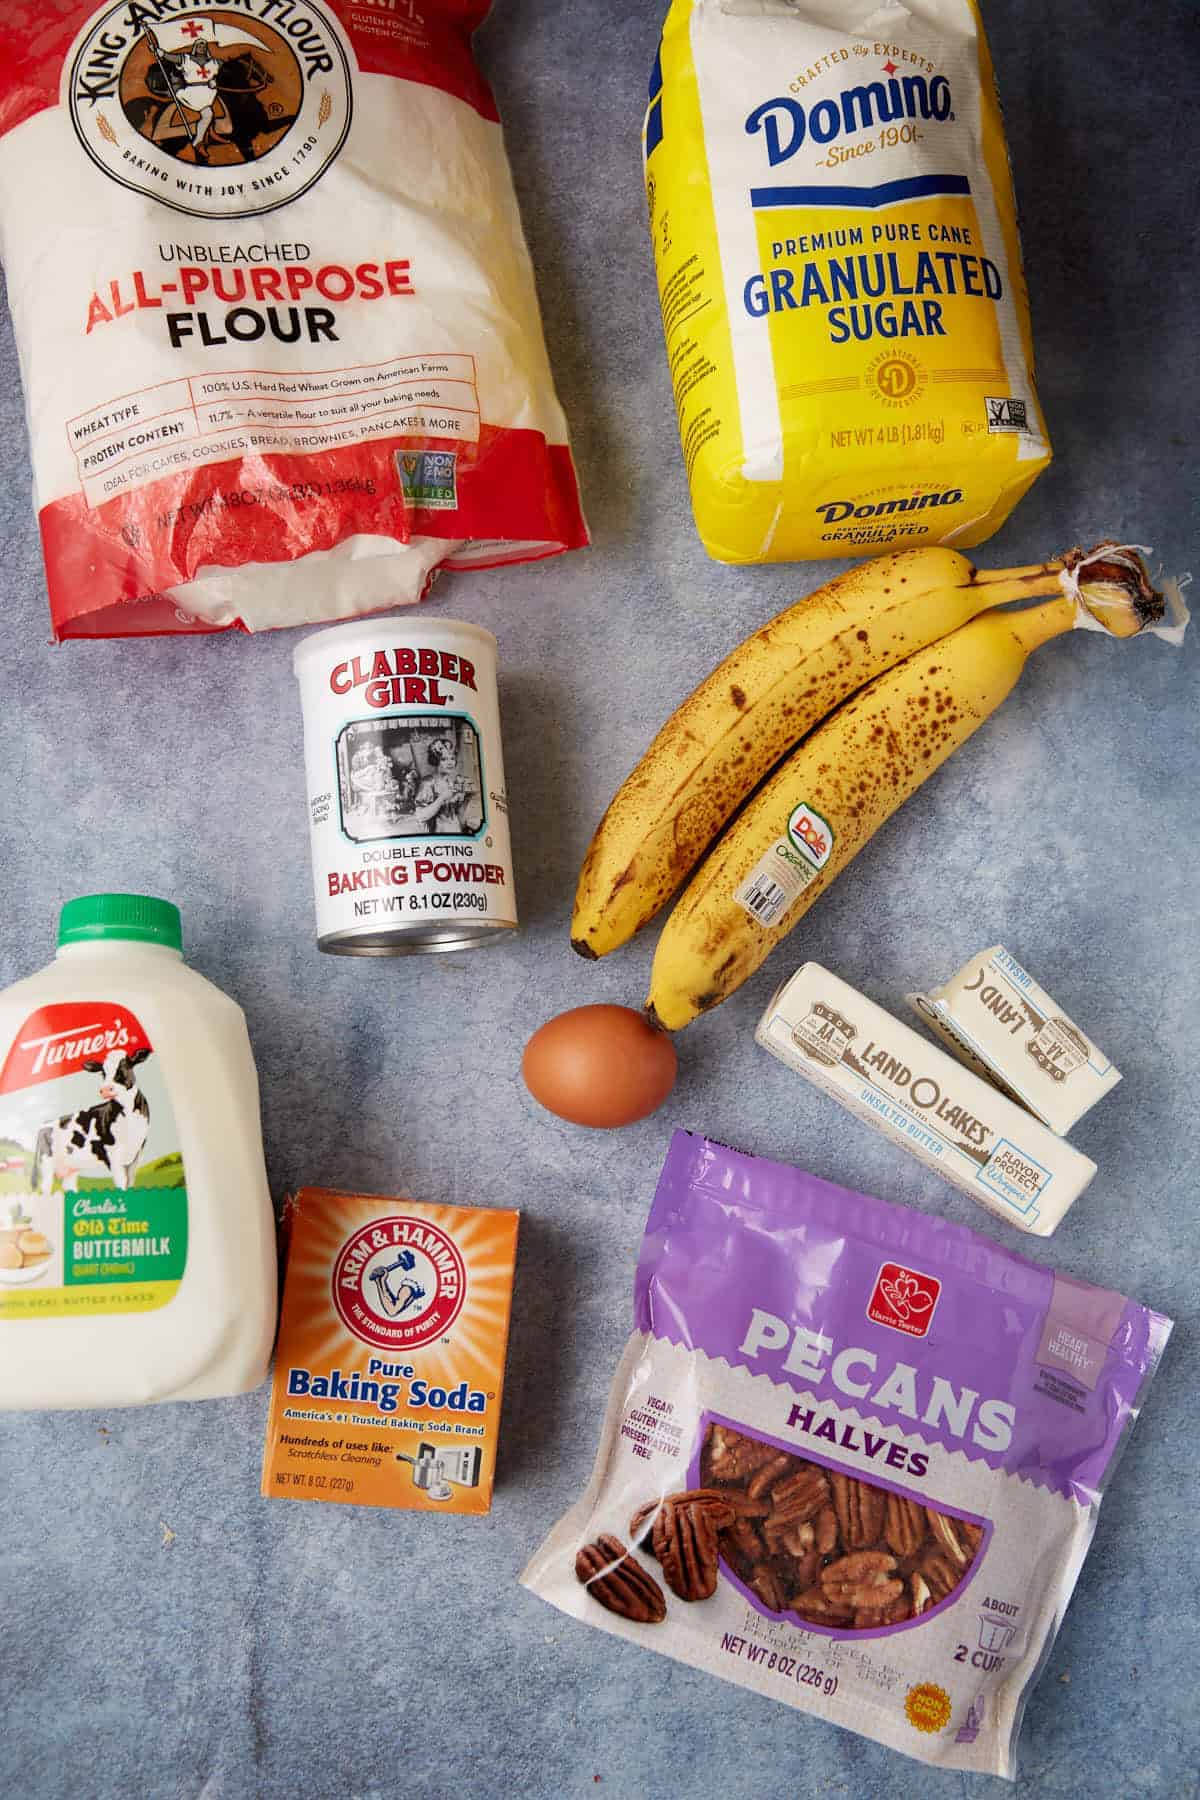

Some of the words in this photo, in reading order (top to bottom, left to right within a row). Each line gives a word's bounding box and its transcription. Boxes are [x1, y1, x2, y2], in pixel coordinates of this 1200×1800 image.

[77, 31, 127, 107] KING
[259, 0, 333, 81] FLOUR
[788, 47, 850, 94] CRAFTED
[852, 44, 869, 57] By
[873, 43, 936, 73] EXPERTS
[744, 73, 952, 168] Domino
[122, 149, 169, 181] BAKING
[176, 178, 213, 196] WITH
[220, 183, 244, 196] JOY
[252, 166, 291, 190] SINCE
[292, 135, 318, 165] 1790
[159, 243, 311, 263] UNBLEACHED
[772, 226, 863, 260] PREMIUM
[871, 224, 922, 242] PURE
[929, 222, 972, 246] CANE
[85, 259, 416, 335] ALL-PURPOSE
[743, 251, 1003, 319] GRANULATED
[166, 306, 339, 348] FLOUR
[828, 301, 947, 344] SUGAR
[202, 382, 230, 394] 100%
[231, 380, 252, 392] U.S.
[254, 381, 277, 392] Hard
[278, 382, 297, 393] Red
[298, 382, 328, 393] Wheat
[330, 377, 361, 389] Grown
[363, 375, 375, 384] on
[377, 365, 420, 381] American
[421, 363, 449, 373] Farms
[73, 415, 109, 441] WHEAT
[111, 404, 140, 425] TYPE
[208, 410, 234, 423] 11.7%
[257, 410, 293, 420] versatile
[295, 410, 317, 421] flour
[319, 408, 329, 418] to
[330, 406, 347, 416] suit
[349, 402, 360, 413] all
[360, 400, 383, 412] your
[384, 393, 414, 404] baking
[414, 389, 441, 399] needs
[83, 440, 125, 469] PROTEIN
[127, 421, 185, 447] CONTENT
[831, 430, 854, 449] NET
[855, 429, 874, 446] WT
[877, 427, 884, 441] 4
[887, 425, 899, 441] LB
[901, 419, 945, 446] (1.81kg)
[102, 473, 129, 493] IDEAL
[129, 464, 151, 482] FOR
[152, 452, 191, 472] CAKES,
[192, 437, 249, 457] COOKIES,
[250, 435, 292, 448] BREAD,
[294, 430, 358, 447] BROWNIES,
[360, 416, 419, 435] PANCAKES
[428, 418, 461, 431] MORE
[424, 454, 454, 466] NON
[157, 505, 184, 530] NET
[815, 488, 962, 524] Domino
[821, 526, 929, 542] GRANULATED
[849, 536, 895, 546] SUGAR
[329, 647, 478, 695] CLABBER
[365, 676, 447, 708] GIRL
[362, 846, 420, 864] DOUBLE
[424, 844, 473, 858] ACTING
[327, 865, 409, 897] BAKING
[415, 859, 506, 886] POWDER
[354, 899, 378, 917] NET
[382, 895, 405, 912] WT
[979, 986, 1026, 1035] LAND
[20, 1018, 129, 1075] Turner's
[816, 1022, 836, 1042] AA
[860, 1041, 913, 1087] LAND
[910, 1077, 941, 1109] O
[935, 1097, 991, 1146] LAKES
[860, 1089, 908, 1129] UNSALTED
[907, 1121, 945, 1156] BUTTER
[993, 1156, 1039, 1192] PROTECT
[1001, 1151, 1041, 1183] FLAVOR
[72, 1218, 104, 1237] Old
[107, 1217, 149, 1235] Time
[72, 1237, 172, 1260] BUTTERMILK
[341, 1239, 370, 1291] ARM
[372, 1228, 388, 1247] &
[392, 1224, 458, 1300] HAMMER
[351, 1303, 366, 1320] THE
[361, 1316, 402, 1338] STANDARD
[404, 1328, 414, 1338] OF
[415, 1311, 441, 1333] PURITY
[871, 1309, 898, 1325] Harris
[1048, 1339, 1090, 1369] HEALTHY
[1056, 1330, 1089, 1354] HEART
[368, 1358, 414, 1378] Pure
[738, 1307, 1017, 1453] PECANS
[287, 1368, 401, 1413] Baking
[408, 1380, 487, 1413] Soda
[647, 1394, 674, 1415] VEGAN
[284, 1409, 333, 1422] America's
[336, 1413, 348, 1422] #1
[352, 1414, 388, 1427] Trusted
[390, 1419, 425, 1432] Baking
[427, 1421, 452, 1433] Soda
[455, 1425, 485, 1436] Brand
[630, 1409, 659, 1429] GLUTEN
[279, 1434, 329, 1449] Hundreds
[332, 1439, 344, 1449] of
[346, 1441, 369, 1451] uses
[371, 1441, 393, 1454] like:
[621, 1424, 681, 1457] PRESERVATIVE
[632, 1444, 653, 1461] FREE
[786, 1403, 930, 1477] HALVES
[287, 1448, 338, 1461] Scratchless
[341, 1452, 382, 1467] Cleaning
[275, 1472, 290, 1485] NET
[308, 1475, 314, 1487] 8
[329, 1477, 354, 1492] (227g)
[981, 1596, 1020, 1617] ABOUT
[720, 1632, 748, 1657] NET
[748, 1643, 770, 1665] WT
[767, 1654, 778, 1670] 8
[778, 1656, 797, 1677] OZ
[953, 1644, 969, 1663] 2
